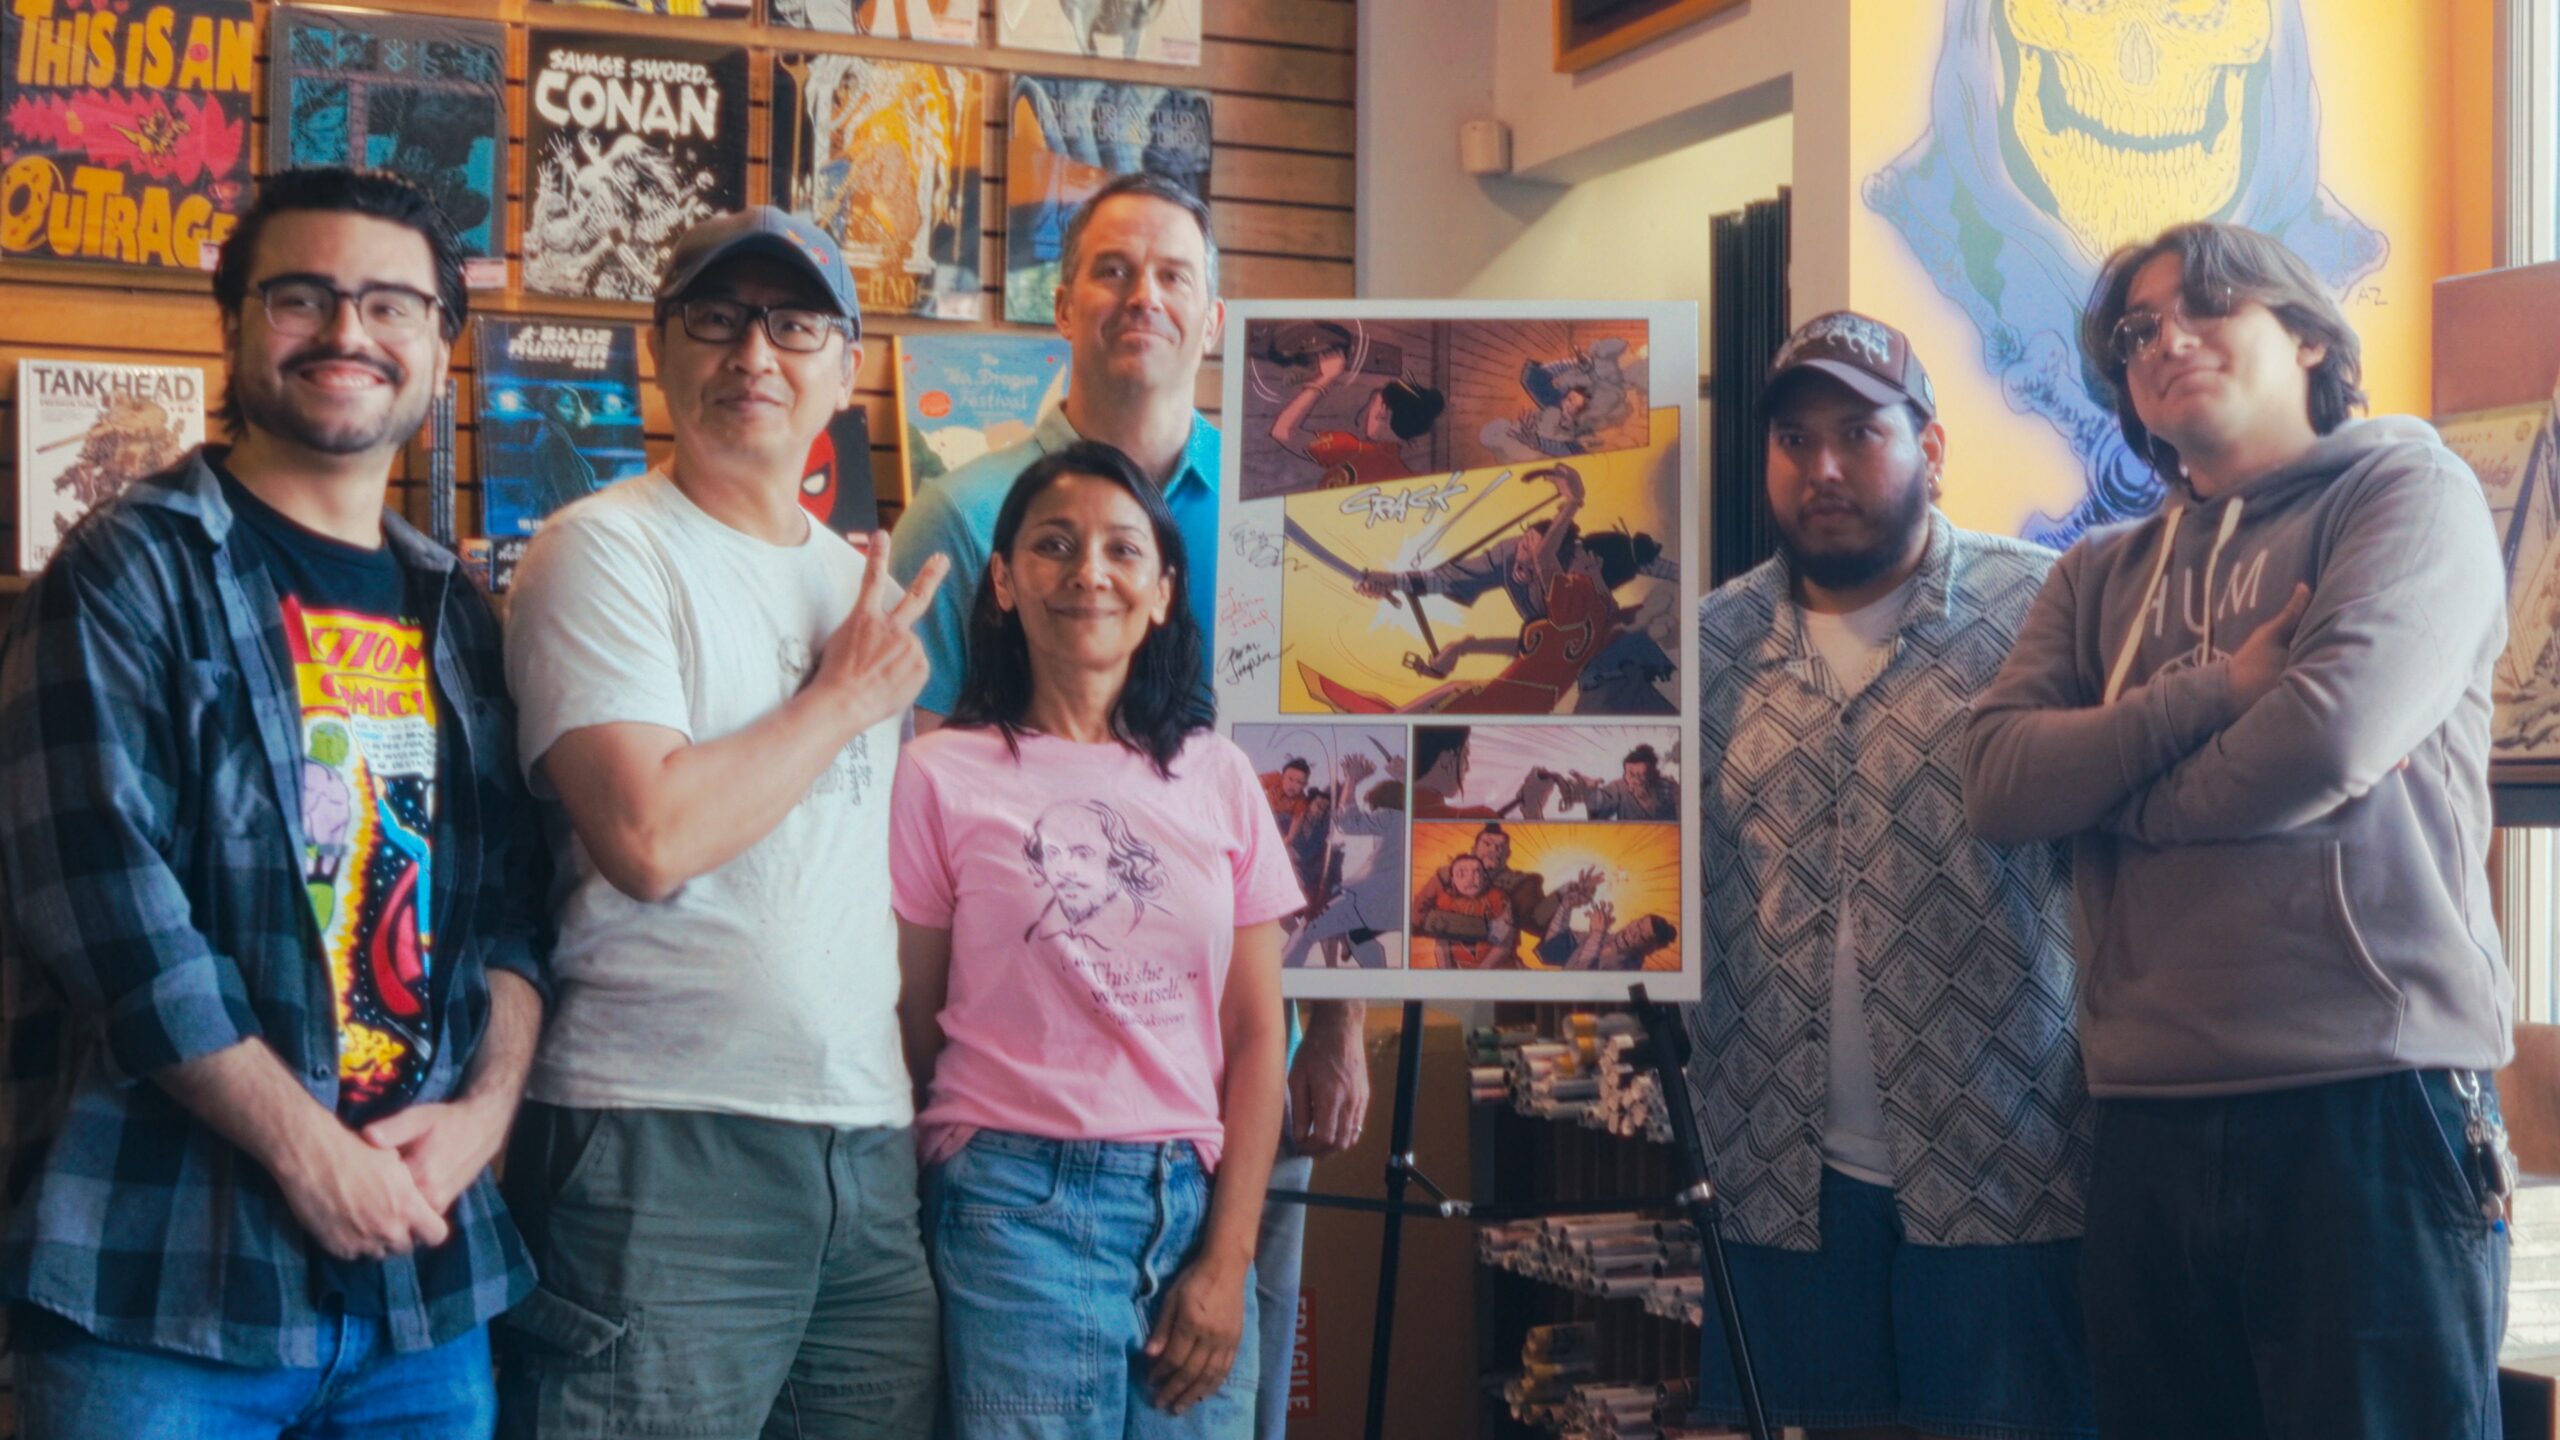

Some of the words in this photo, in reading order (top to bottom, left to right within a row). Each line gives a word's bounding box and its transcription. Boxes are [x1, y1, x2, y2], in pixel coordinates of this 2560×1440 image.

[14, 0, 118, 89] THIS
[123, 6, 176, 89] IS
[177, 16, 254, 92] AN
[549, 49, 626, 79] SAVAGE
[630, 59, 707, 86] SWORD
[535, 69, 719, 140] CONAN
[33, 368, 196, 402] TANKHEAD
[311, 628, 423, 674] CTION
